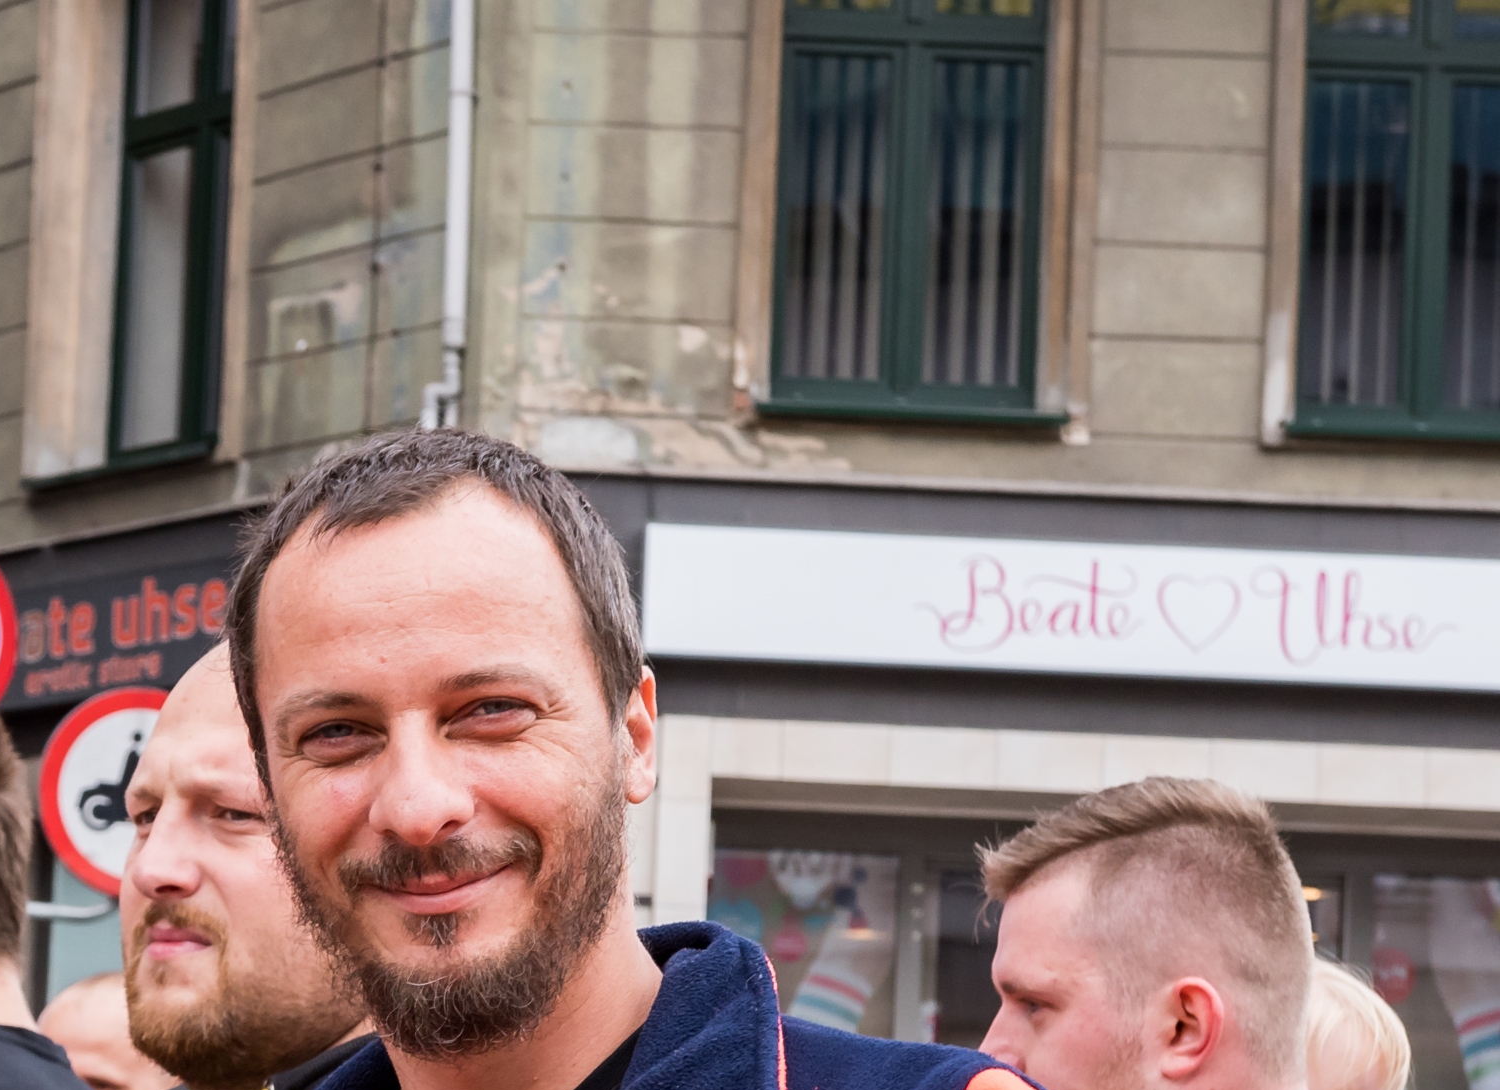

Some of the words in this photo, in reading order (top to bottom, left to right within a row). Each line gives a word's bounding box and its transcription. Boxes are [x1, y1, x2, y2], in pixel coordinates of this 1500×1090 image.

[19, 597, 96, 664] ate
[110, 574, 230, 649] uhse
[915, 553, 1145, 655] Beate
[1249, 564, 1457, 668] Uhse
